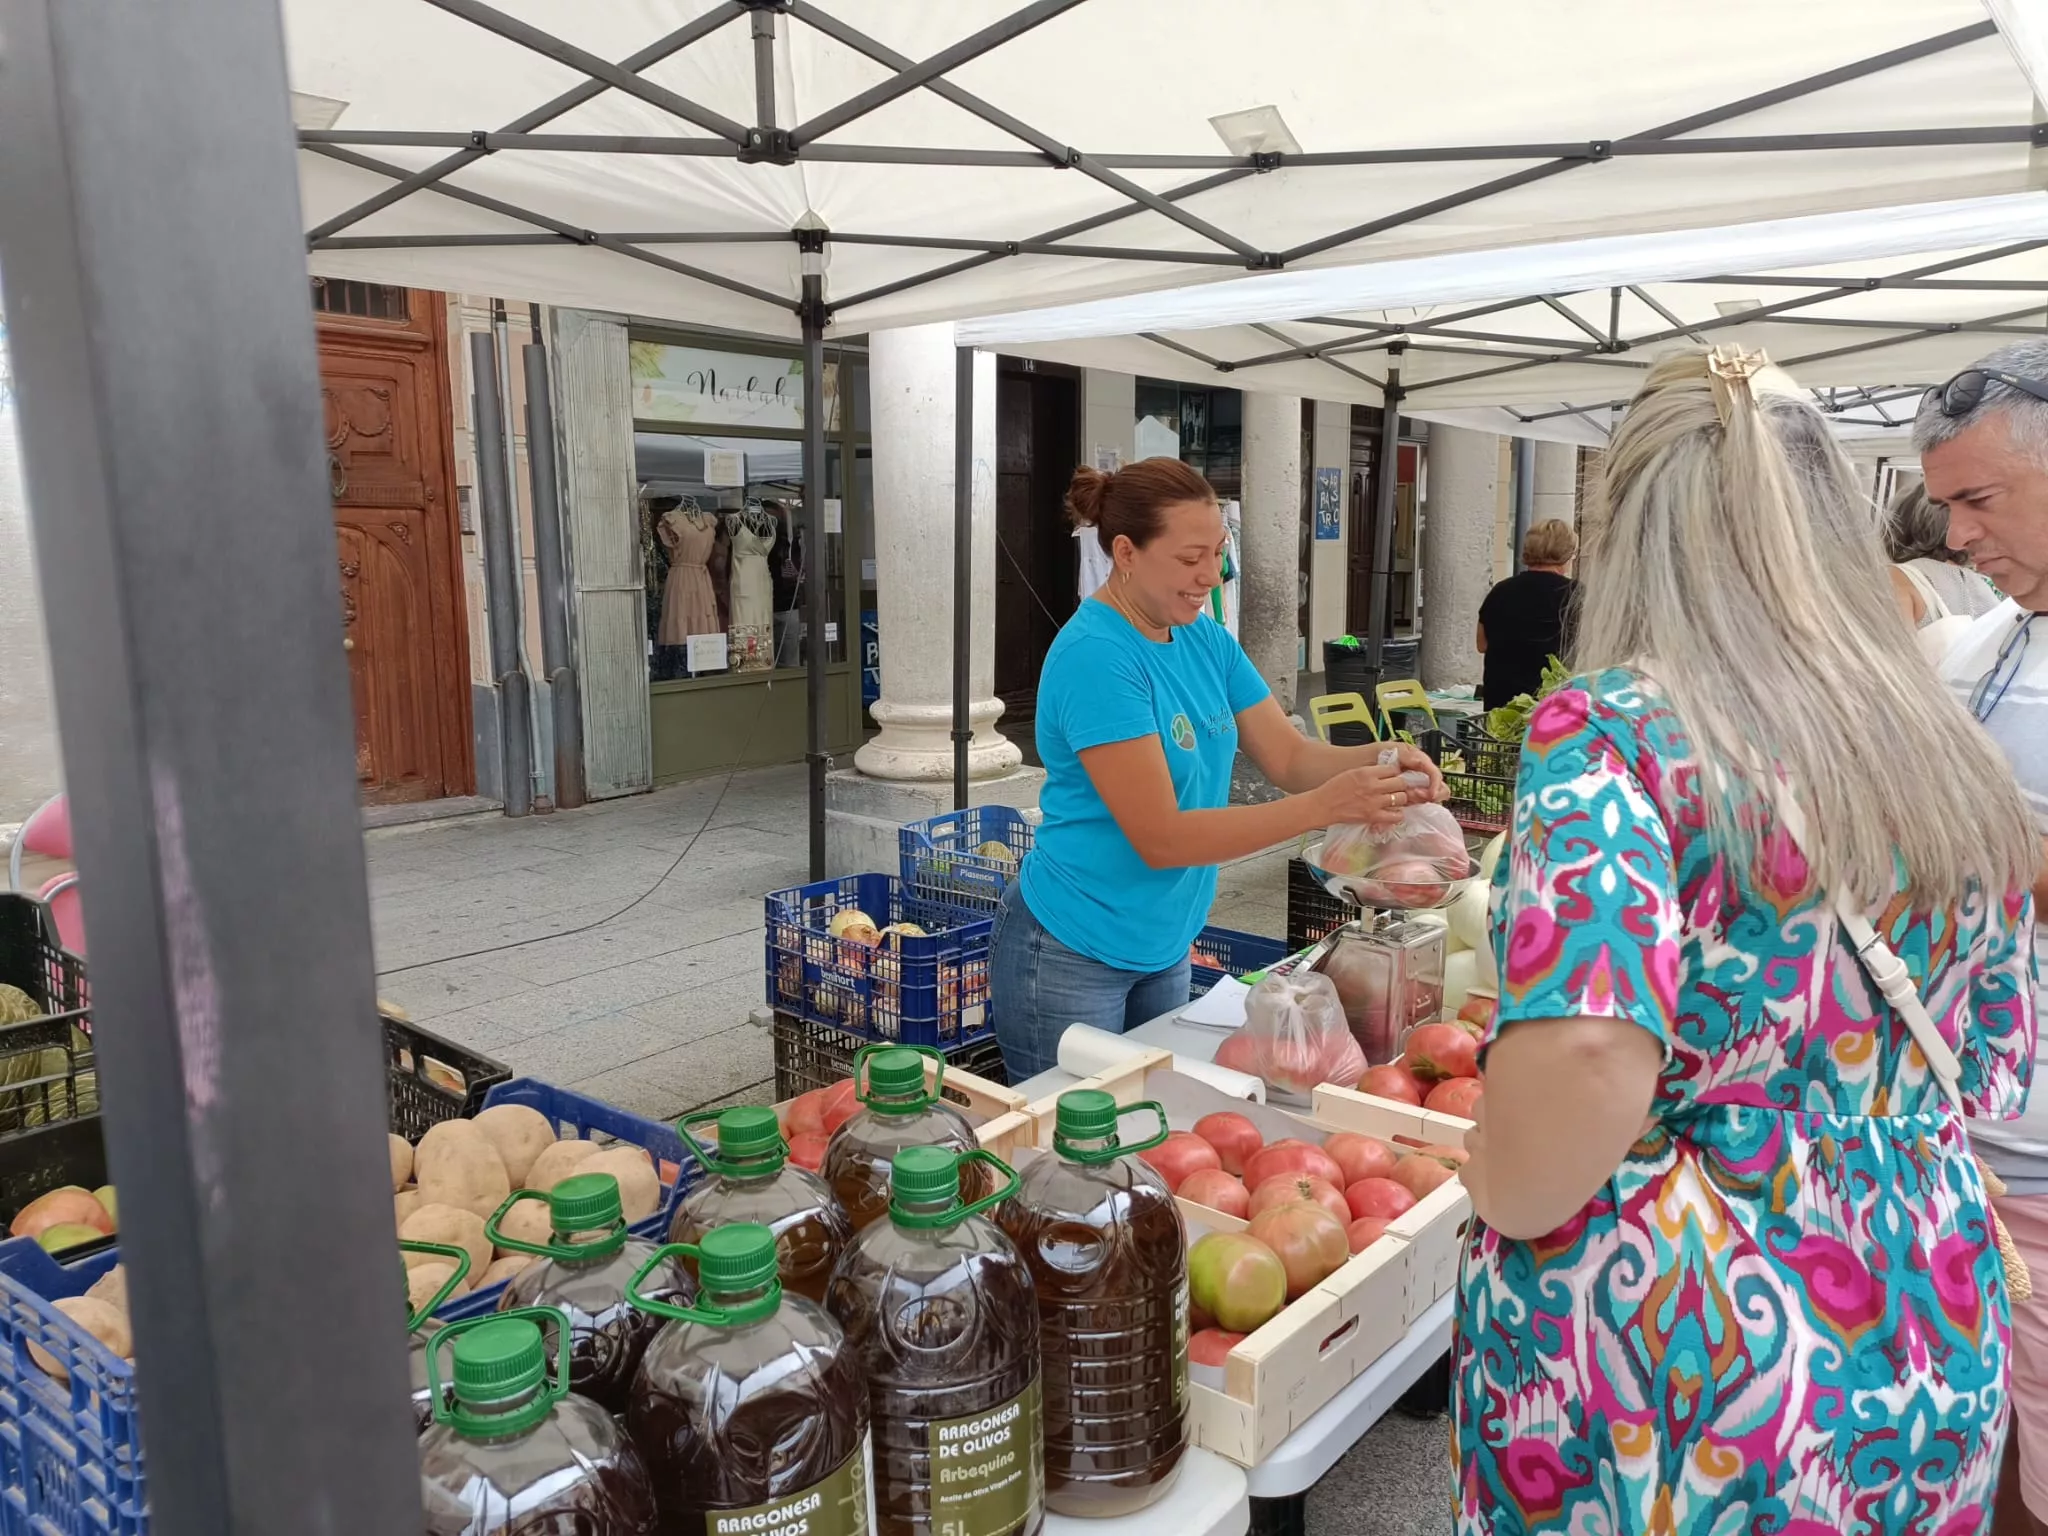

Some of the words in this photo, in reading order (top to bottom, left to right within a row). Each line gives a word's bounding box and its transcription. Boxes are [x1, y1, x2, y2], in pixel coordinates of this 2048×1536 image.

[686, 367, 792, 407] Nailah
[938, 1402, 1020, 1441] ARAGONESA
[939, 1443, 960, 1459] DE
[962, 1426, 1012, 1454] OLIVOS
[716, 1492, 821, 1533] ARAGONESA
